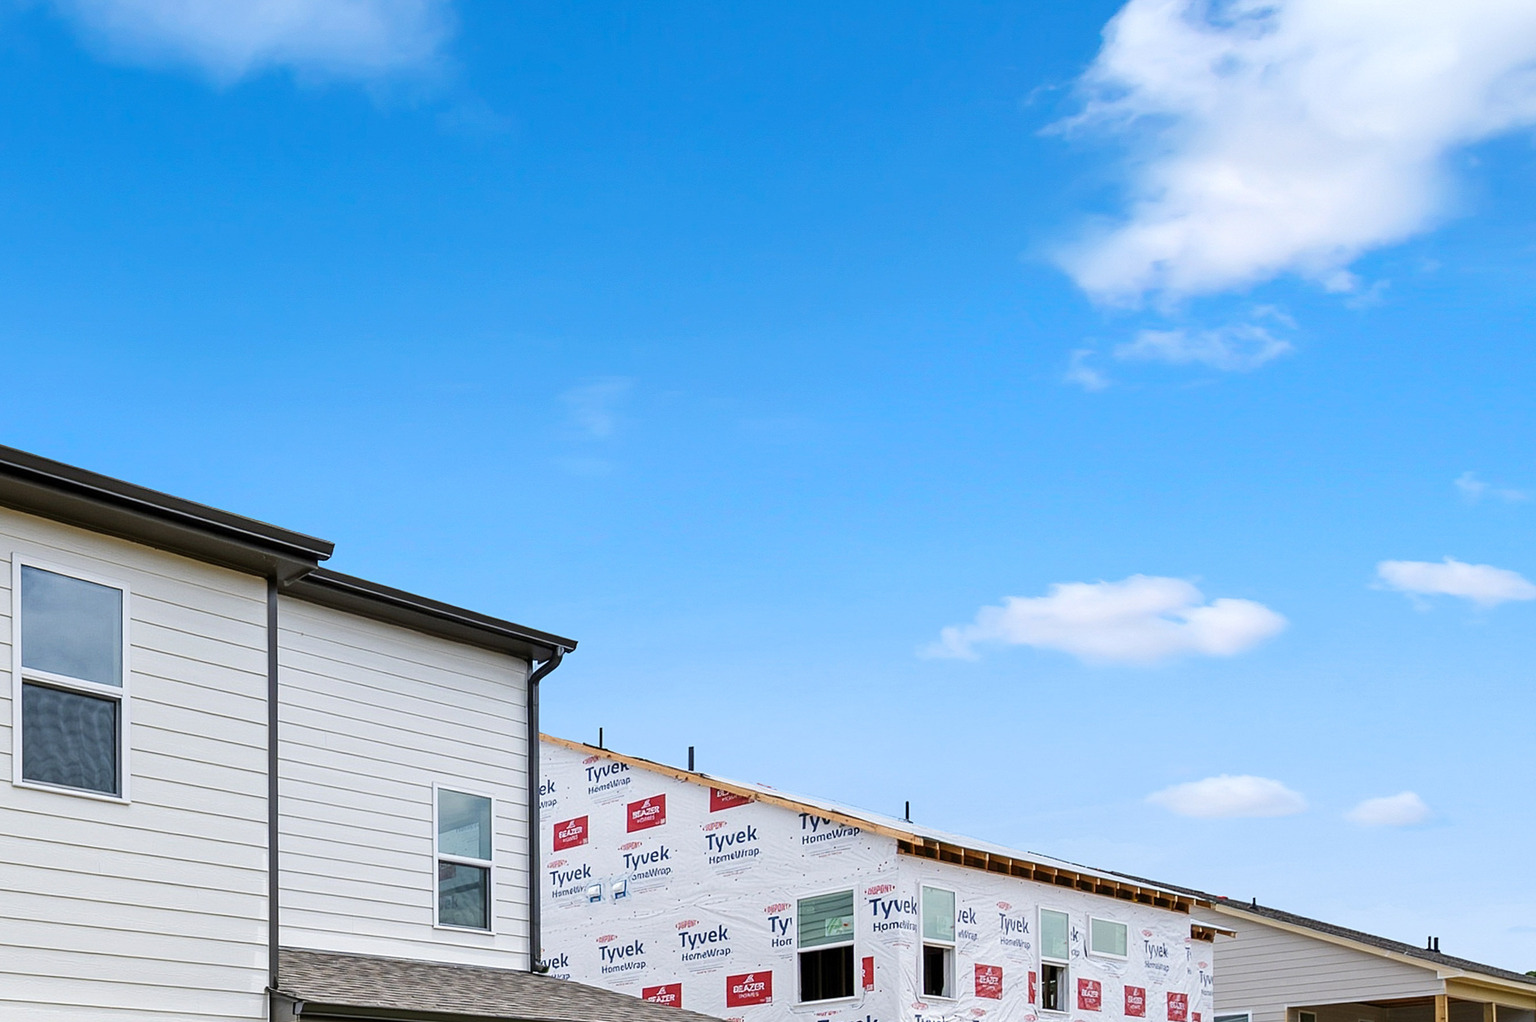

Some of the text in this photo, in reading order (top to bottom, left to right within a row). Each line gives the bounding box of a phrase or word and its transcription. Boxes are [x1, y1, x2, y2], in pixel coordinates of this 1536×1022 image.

[585, 761, 630, 783] Tyvek
[705, 825, 757, 852] Tyvek
[802, 827, 860, 845] HomeWrap
[623, 845, 670, 871] Tyvek
[709, 848, 760, 864] HomeWrap
[549, 863, 592, 888] Tyvek
[631, 867, 672, 881] omeWrap
[869, 896, 917, 919] Tyvek
[998, 912, 1029, 935] Tyvek
[678, 924, 728, 950] Tyvek
[598, 939, 644, 963] Tyvek
[682, 947, 731, 961] HomeWrap
[601, 961, 646, 974] HomeWrap
